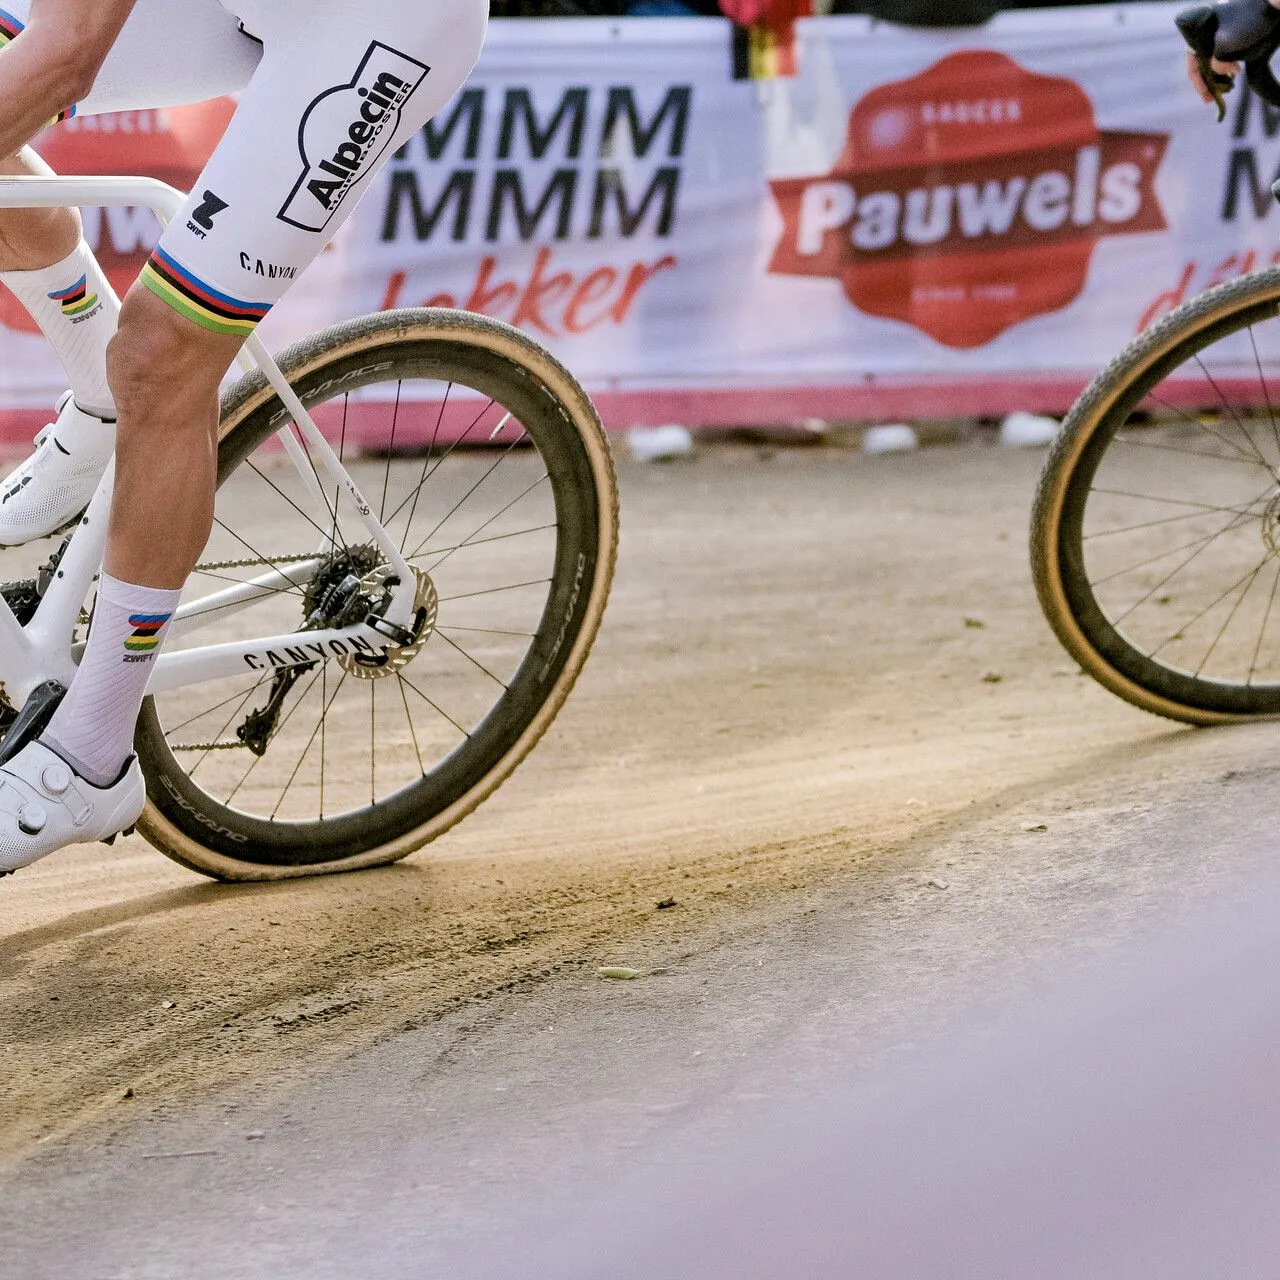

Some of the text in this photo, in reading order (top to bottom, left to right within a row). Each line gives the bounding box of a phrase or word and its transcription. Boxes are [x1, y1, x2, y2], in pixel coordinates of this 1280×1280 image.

[306, 71, 404, 211] Alpecin
[328, 82, 412, 211] HAIR BOOSTER
[380, 165, 682, 243] MMM
[796, 145, 1144, 256] Pauwels
[186, 220, 208, 241] ZWIFT
[239, 251, 298, 280] CANYON
[69, 302, 104, 325] ZWIFT
[122, 653, 155, 663] ZWIFT
[243, 635, 377, 670] CANYON
